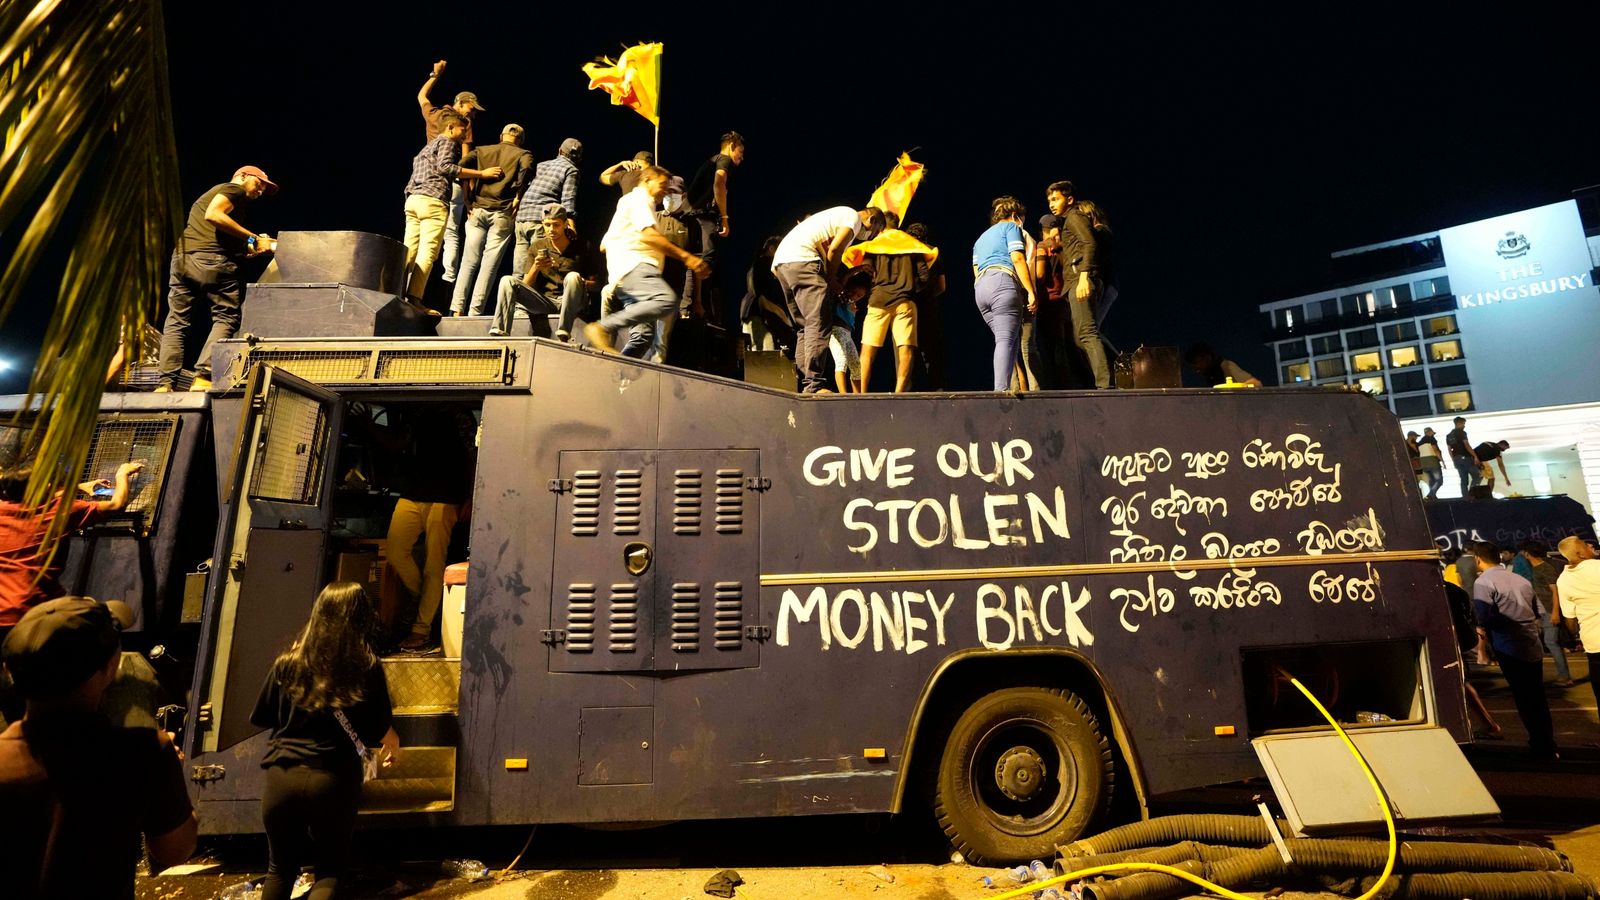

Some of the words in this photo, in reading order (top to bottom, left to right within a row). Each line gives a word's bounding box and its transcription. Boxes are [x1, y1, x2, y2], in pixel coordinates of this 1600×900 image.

[1461, 274, 1587, 309] KINGSBURY
[1497, 262, 1543, 281] THE
[803, 446, 915, 488] GIVE
[937, 439, 1034, 487] OUR
[843, 486, 1070, 553] STOLEN
[776, 587, 954, 654] MONEY
[977, 581, 1094, 650] BACK
